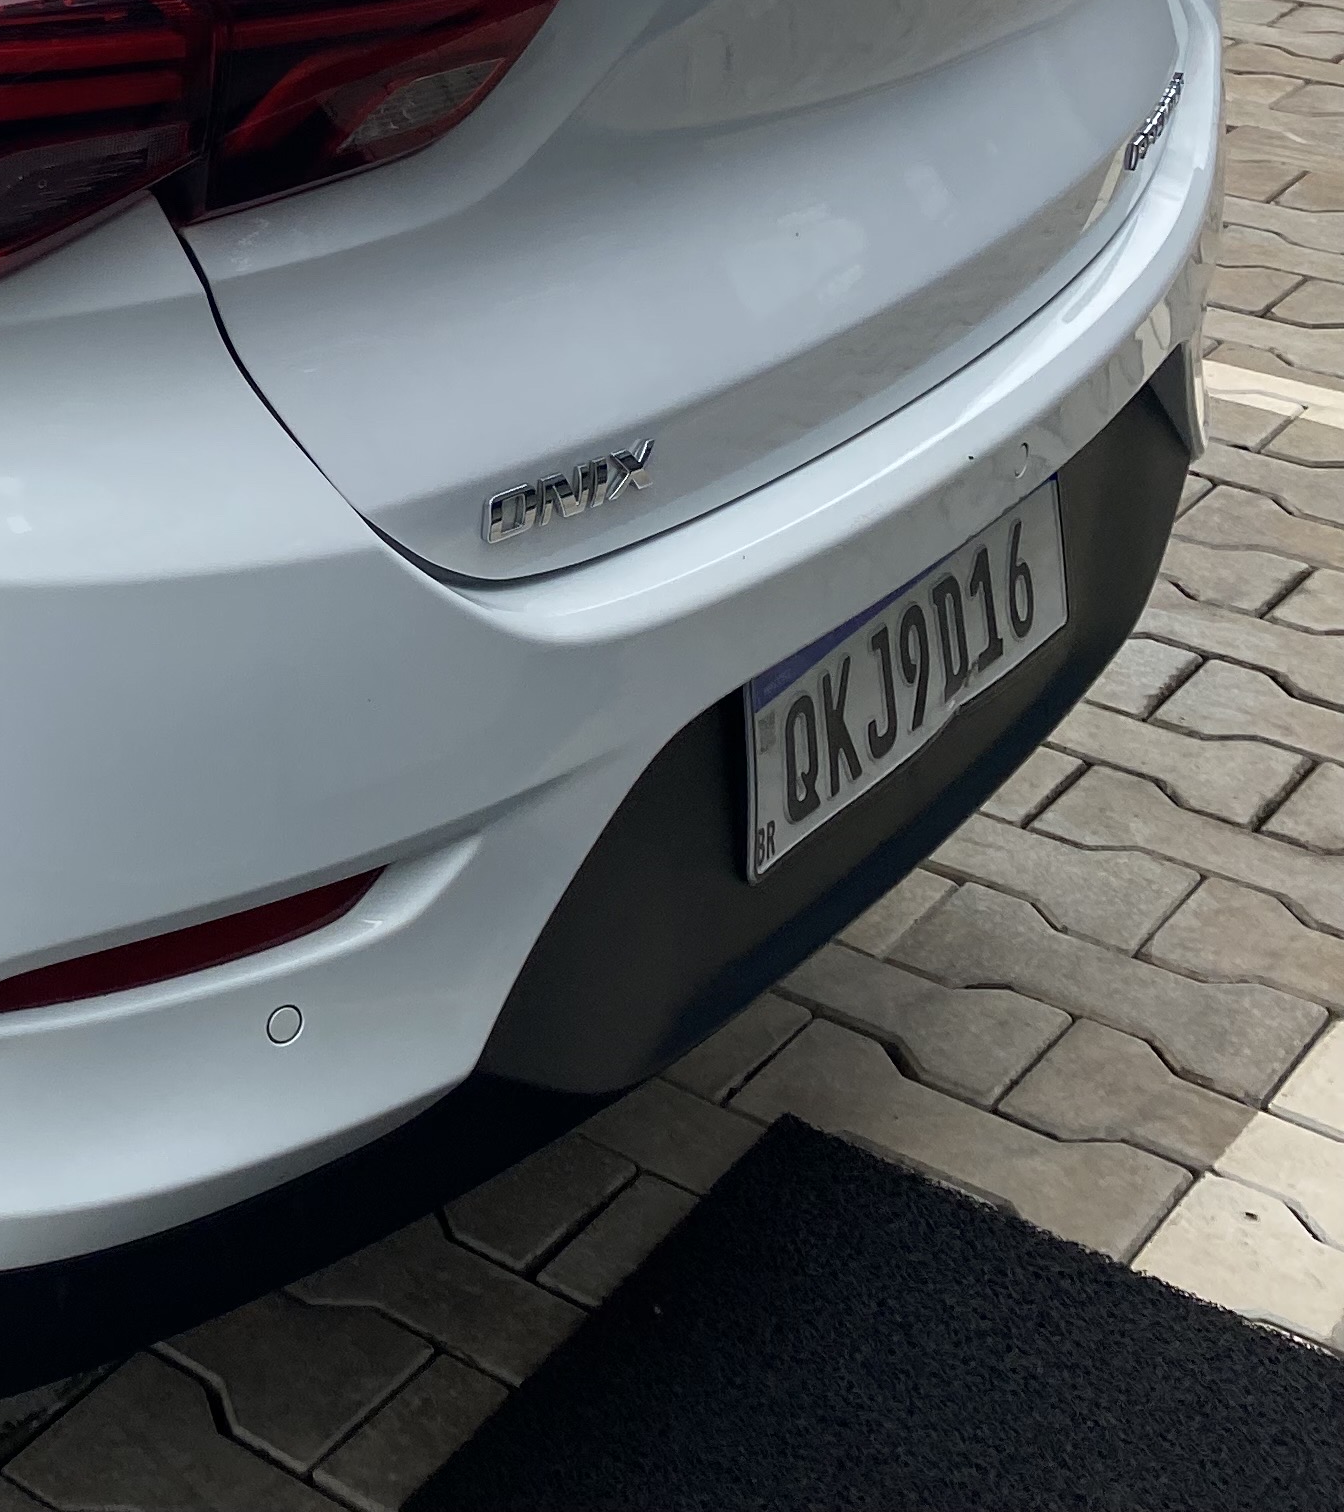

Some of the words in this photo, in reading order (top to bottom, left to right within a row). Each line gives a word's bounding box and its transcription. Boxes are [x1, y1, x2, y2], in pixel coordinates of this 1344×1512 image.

[481, 439, 655, 544] ONIX
[785, 518, 1036, 825] QKJ9D16
[755, 820, 776, 865] BR
